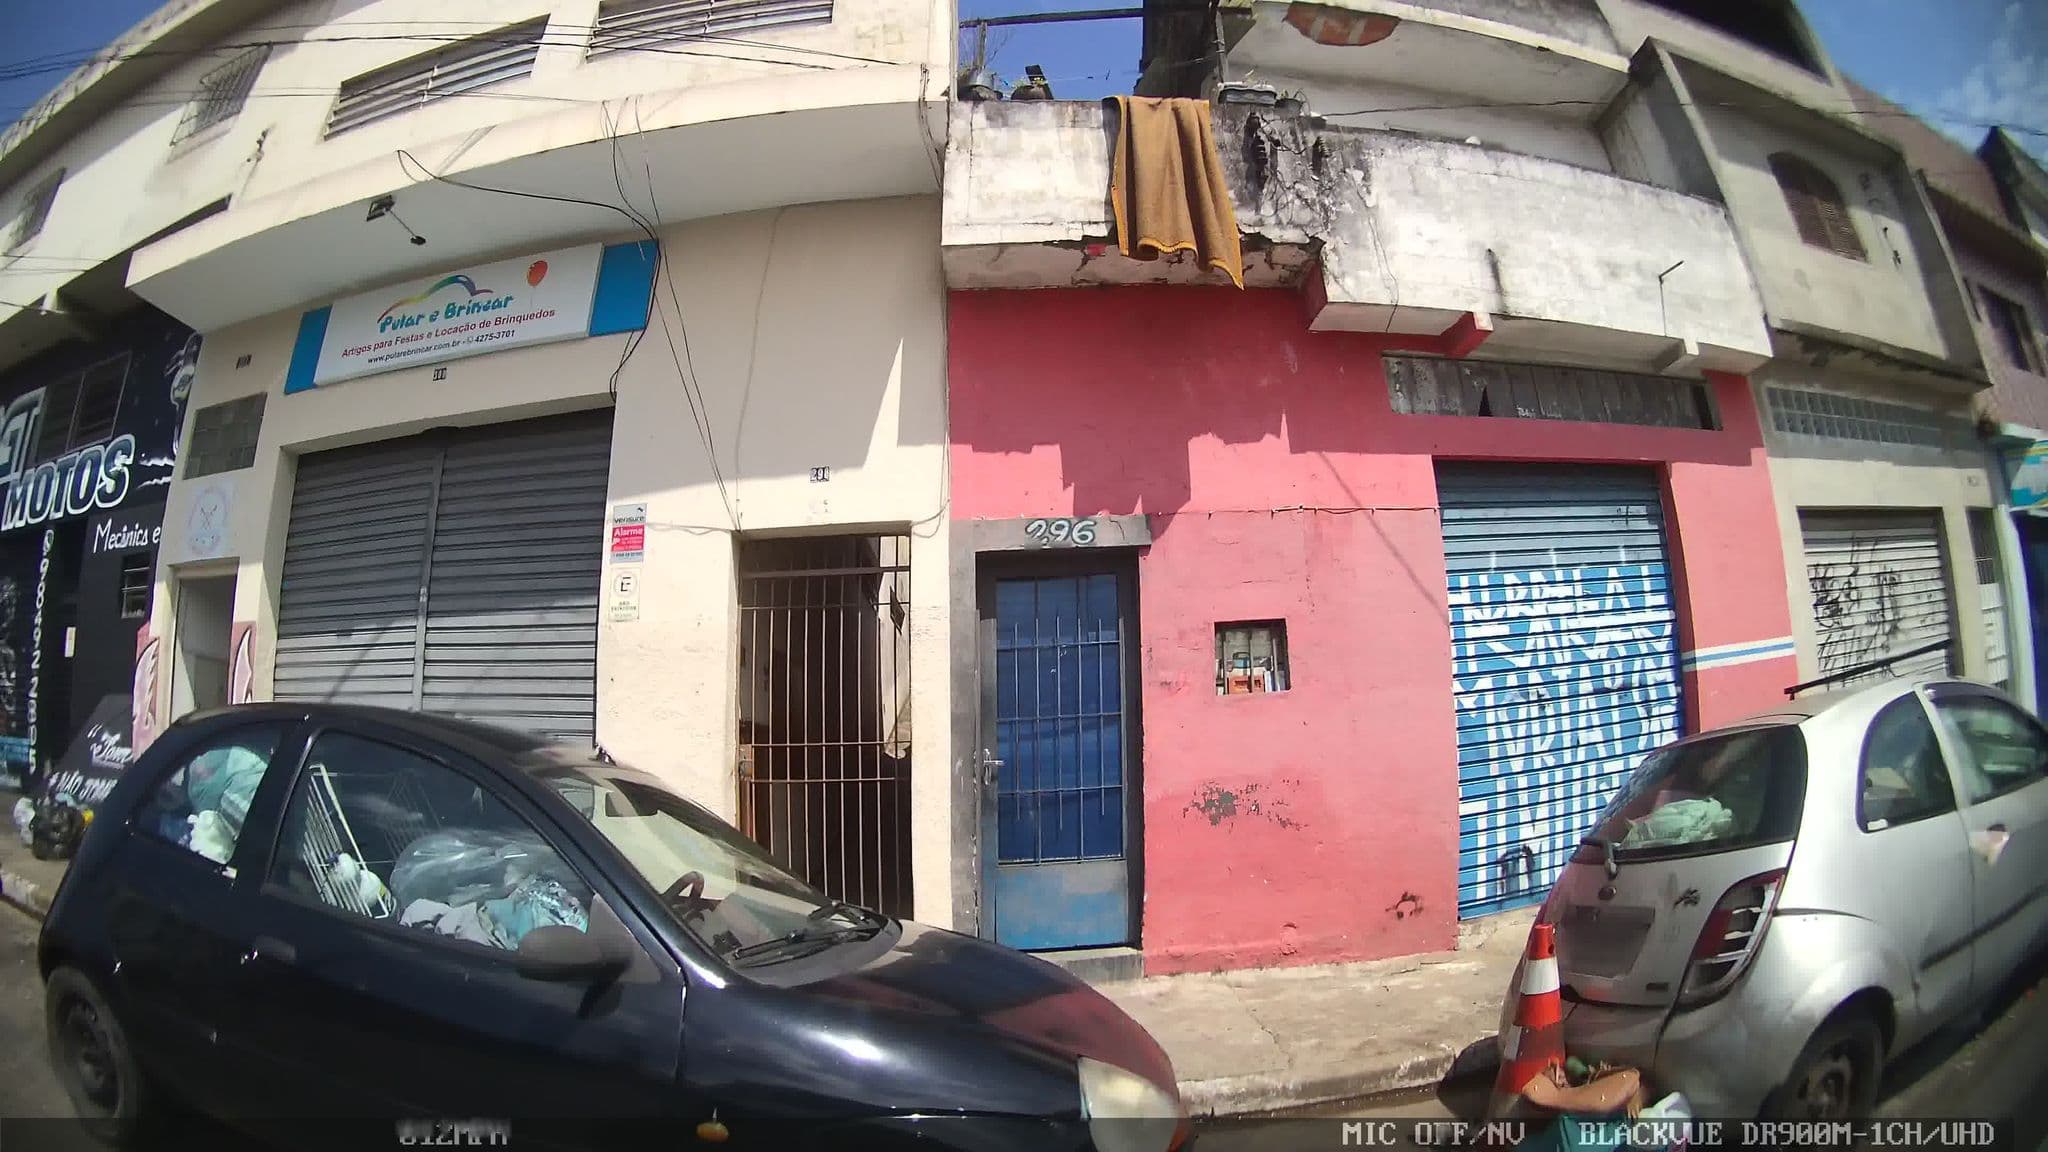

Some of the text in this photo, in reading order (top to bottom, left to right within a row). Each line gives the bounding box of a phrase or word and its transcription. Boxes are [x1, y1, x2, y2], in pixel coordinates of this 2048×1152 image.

[380, 295, 515, 333] Pular e Brincar
[341, 343, 375, 358] Artigos
[373, 339, 393, 352] para
[394, 332, 424, 346] Festas
[435, 321, 476, 337] Locação
[479, 320, 491, 329] de
[494, 309, 555, 326] Brinquedos
[475, 329, 515, 342] 4275-3701
[1, 434, 136, 532] MOTOS
[1025, 519, 1097, 545] 296
